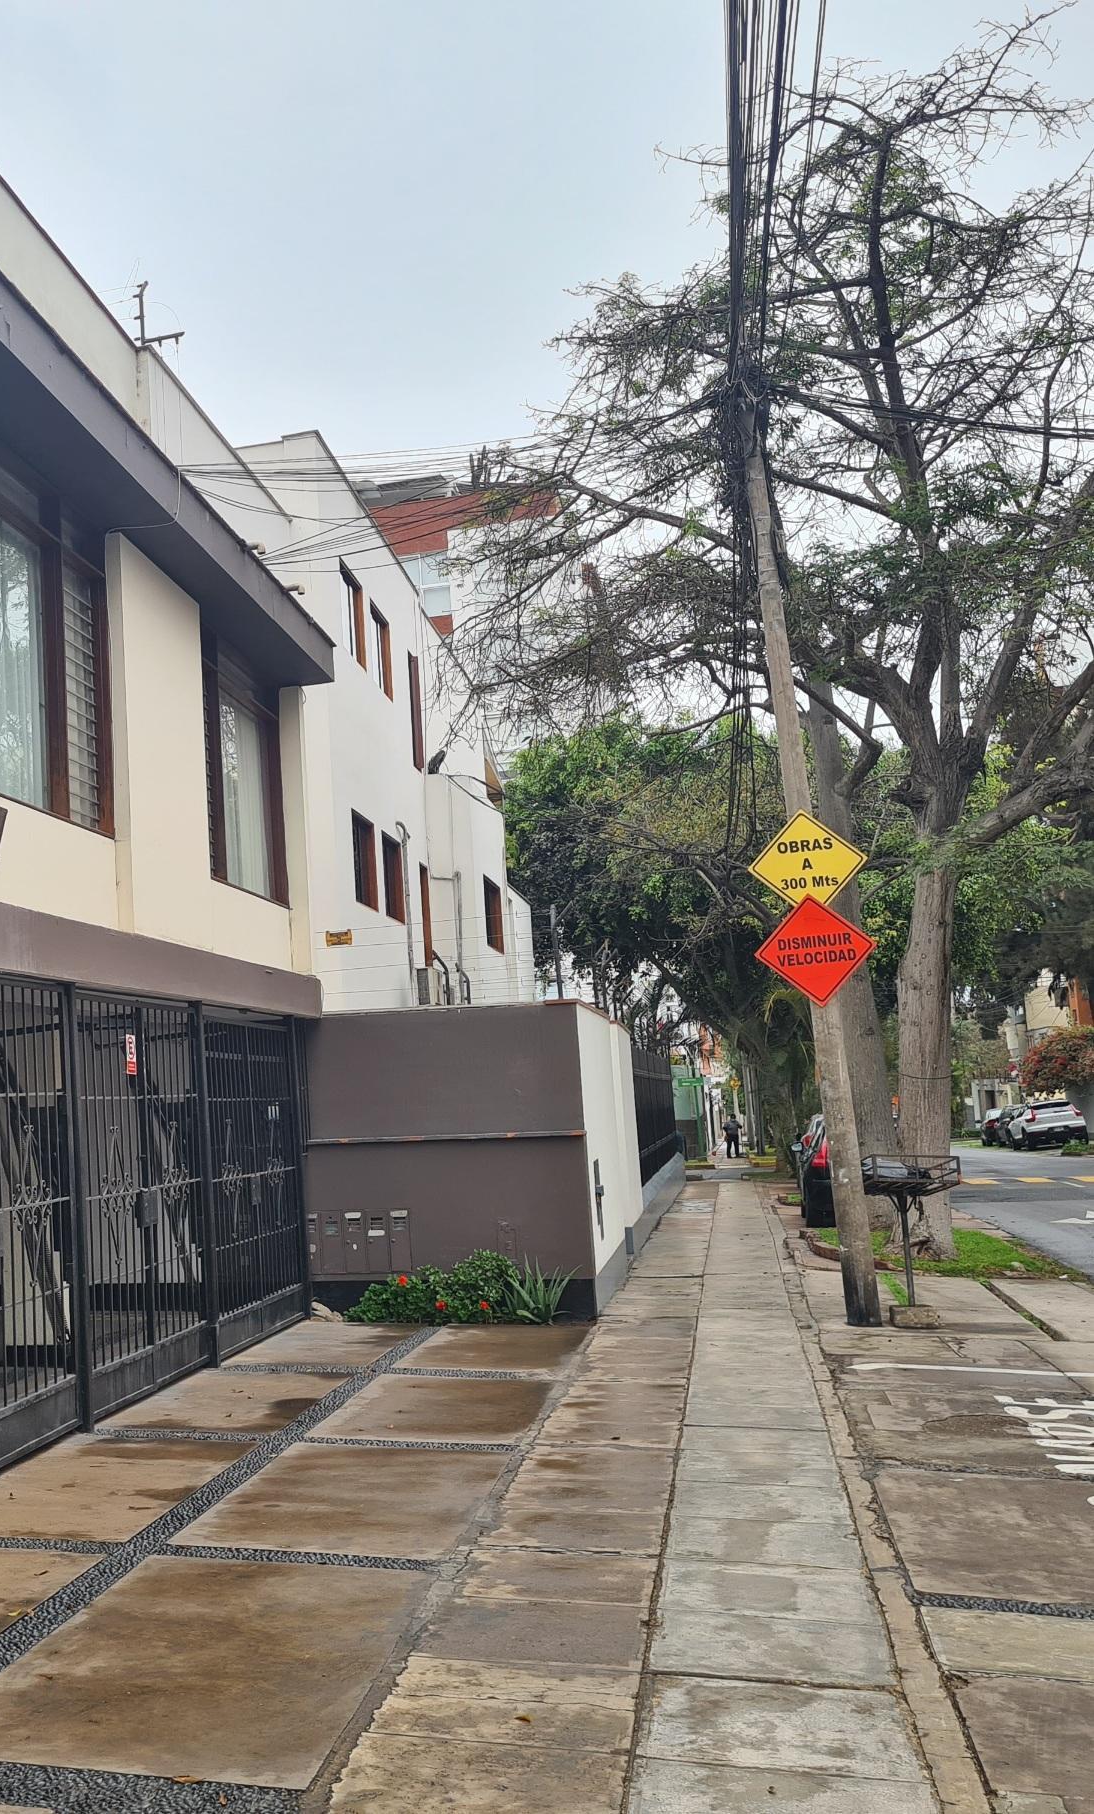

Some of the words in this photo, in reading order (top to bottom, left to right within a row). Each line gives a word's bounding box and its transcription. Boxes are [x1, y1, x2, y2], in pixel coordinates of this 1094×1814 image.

[777, 838, 833, 854] OBRAS
[802, 858, 813, 870] A
[780, 877, 807, 890] 300
[812, 875, 839, 888] Mts
[777, 933, 853, 951] DISMINUIR
[777, 948, 857, 967] VELOCIDAD
